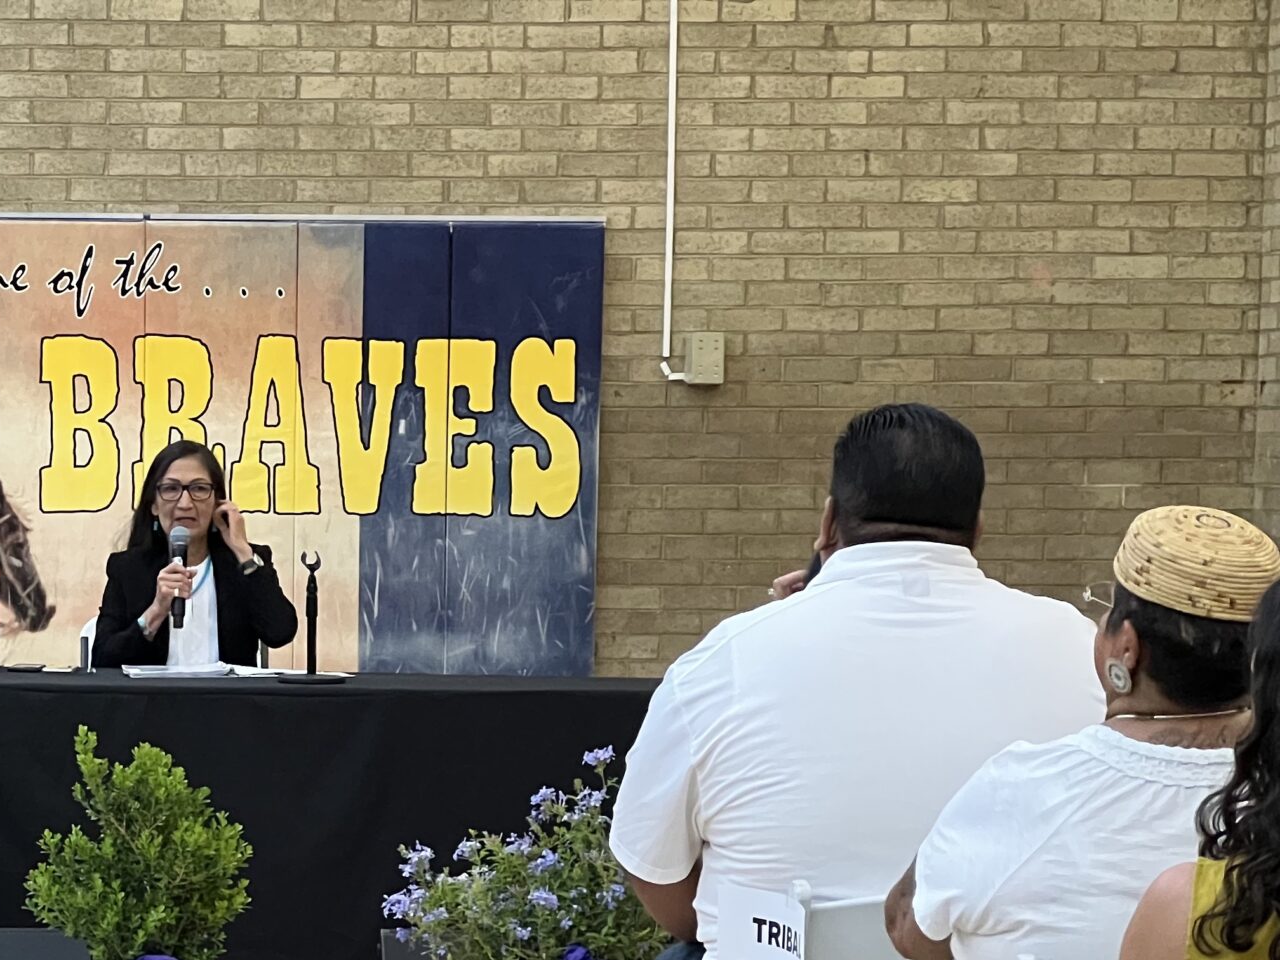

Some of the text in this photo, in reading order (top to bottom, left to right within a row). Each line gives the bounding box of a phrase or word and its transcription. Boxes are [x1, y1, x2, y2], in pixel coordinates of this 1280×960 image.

[46, 243, 95, 319] of
[111, 240, 182, 298] the
[39, 333, 584, 519] BRAVES
